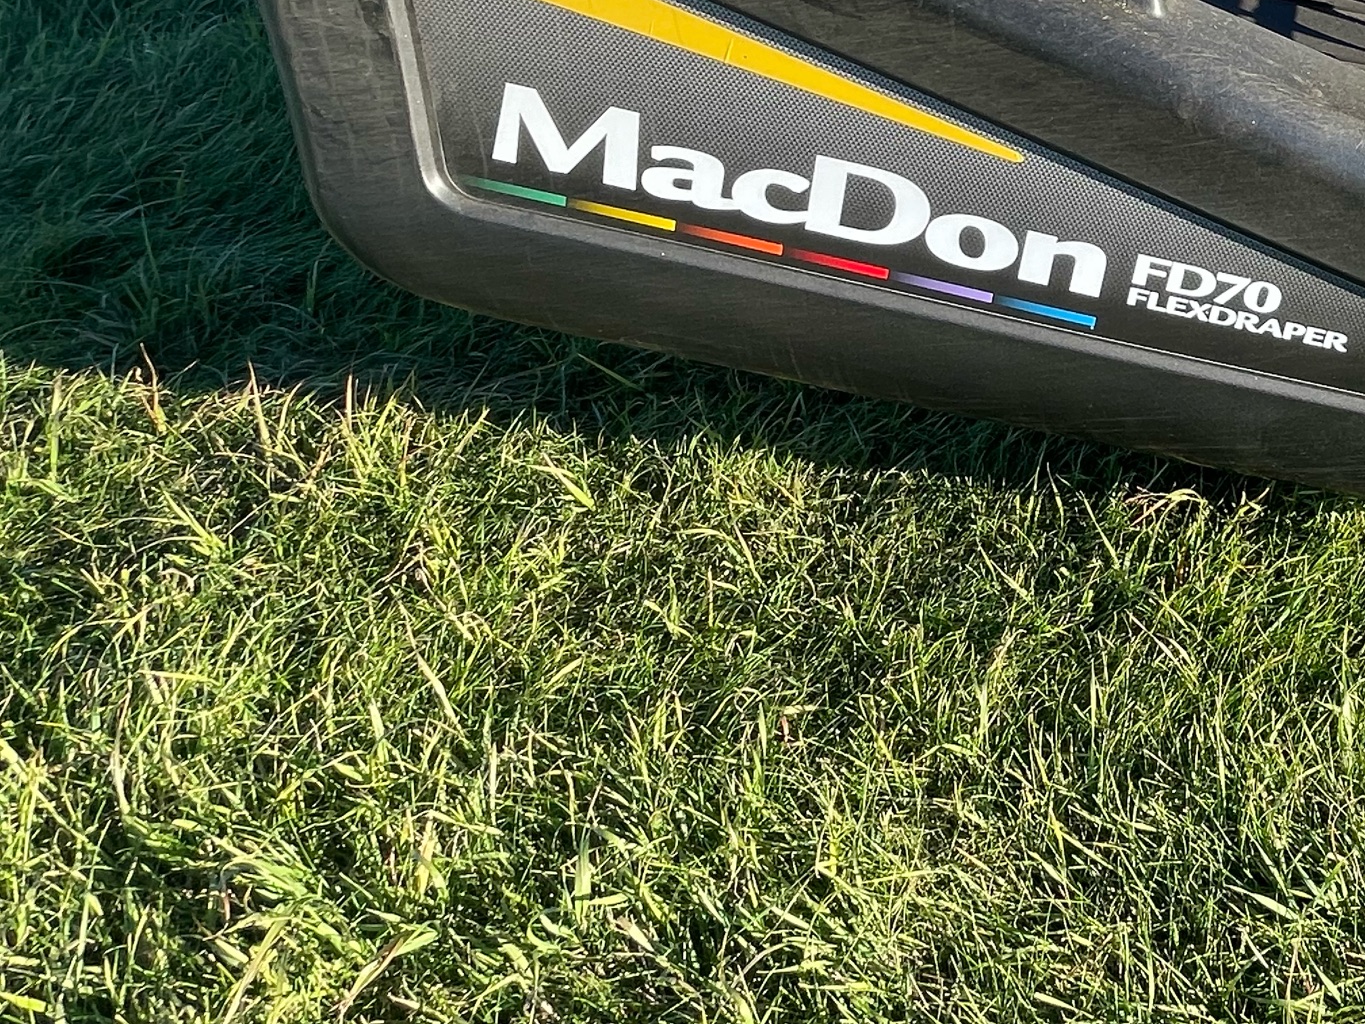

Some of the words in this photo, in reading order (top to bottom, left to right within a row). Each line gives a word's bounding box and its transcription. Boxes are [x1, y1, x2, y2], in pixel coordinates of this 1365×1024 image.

[492, 82, 1107, 297] MacDon
[1131, 254, 1283, 314] FD70
[1126, 286, 1349, 354] FLEXDRAPER
